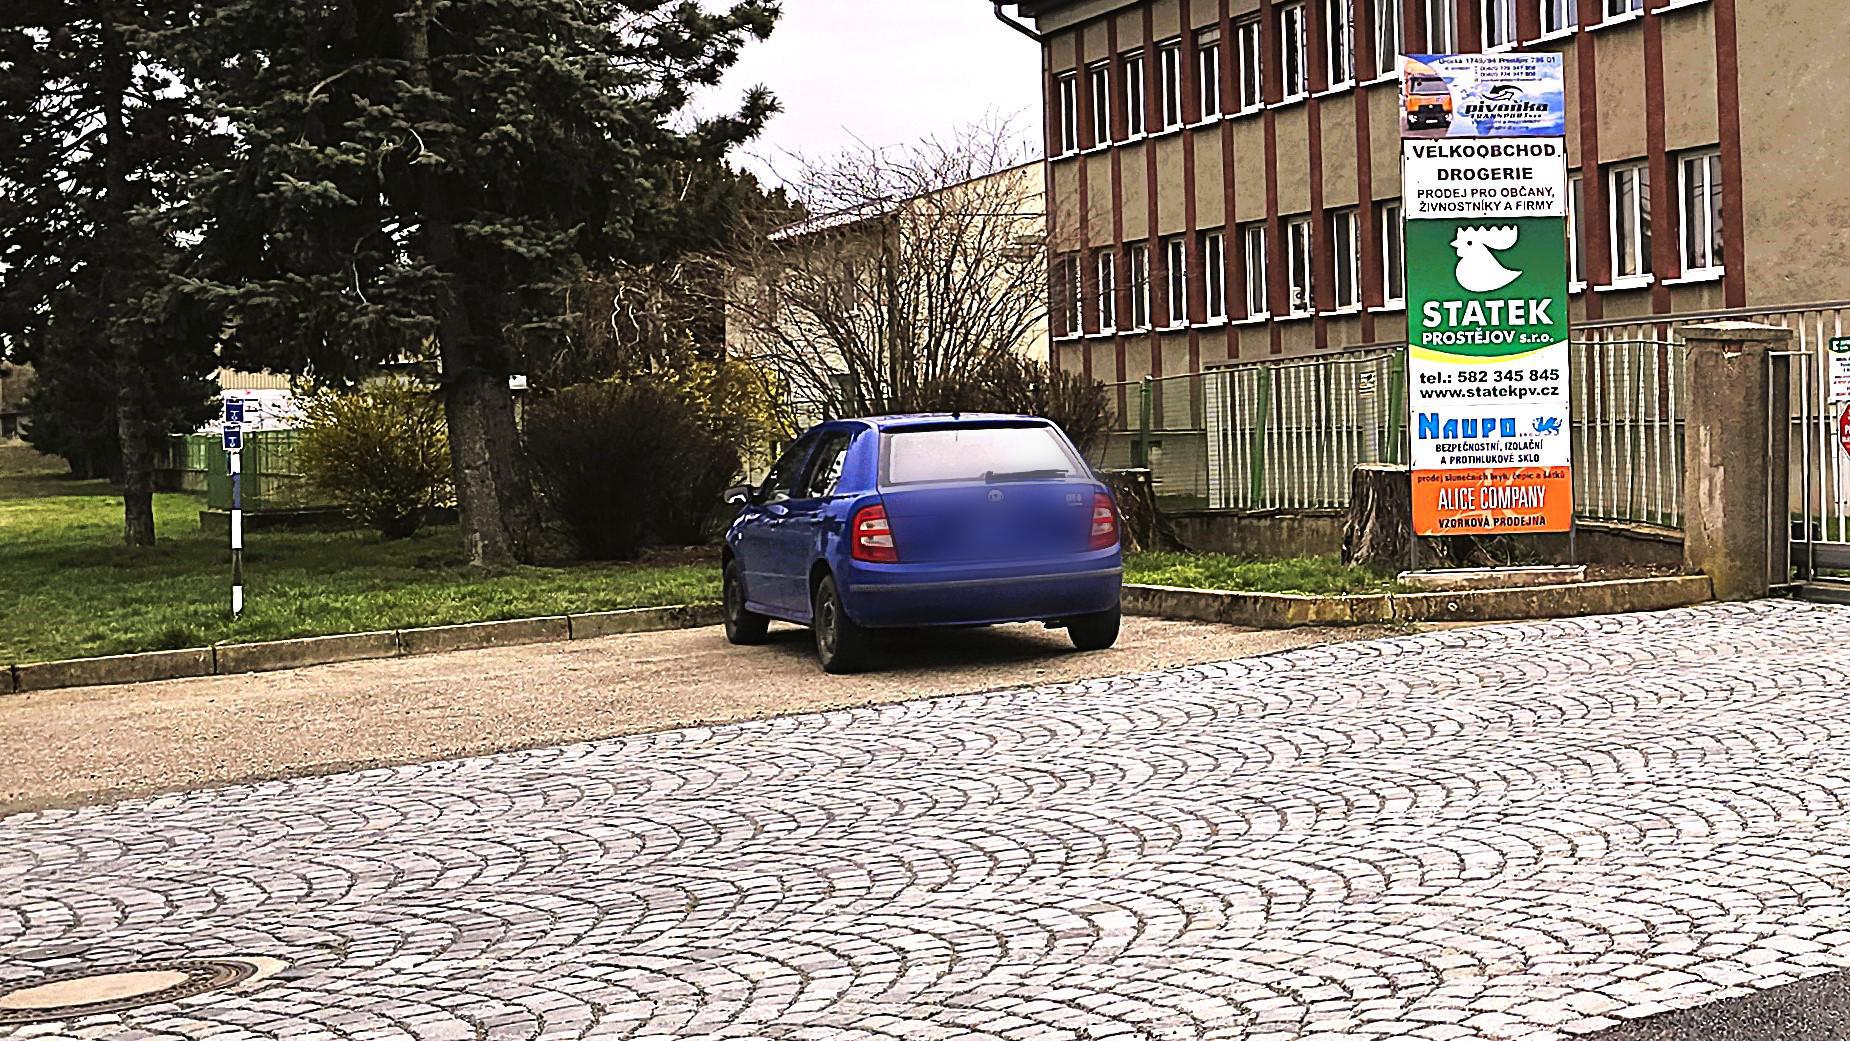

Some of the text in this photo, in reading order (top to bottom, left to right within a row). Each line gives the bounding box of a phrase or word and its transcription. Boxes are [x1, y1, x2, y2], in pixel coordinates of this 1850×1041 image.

[1465, 100, 1549, 114] pivoňka
[1412, 144, 1556, 159] VELKOOBCHOD
[1437, 167, 1533, 181] DROGERIE
[1417, 185, 1555, 199] PRODEJ PRO OBČANY,
[1419, 200, 1554, 213] ŽIVNOSTNÍKY A FIRMY
[1422, 298, 1554, 328] STATEK
[1422, 327, 1554, 345] PROSTĚJOV s.r.o.
[1420, 369, 1560, 384] tel.: 582 345 845
[1420, 385, 1560, 400] www.statekpv.cz
[1504, 439, 1543, 451] IZOLAČNÍ
[1441, 453, 1540, 464] A PROTIHLUKOVÉ SKLO
[1417, 473, 1443, 484] prodej
[1438, 484, 1546, 511] ALICE COMPANY
[1438, 515, 1546, 529] VZORKOVÁ PRODEJNA
